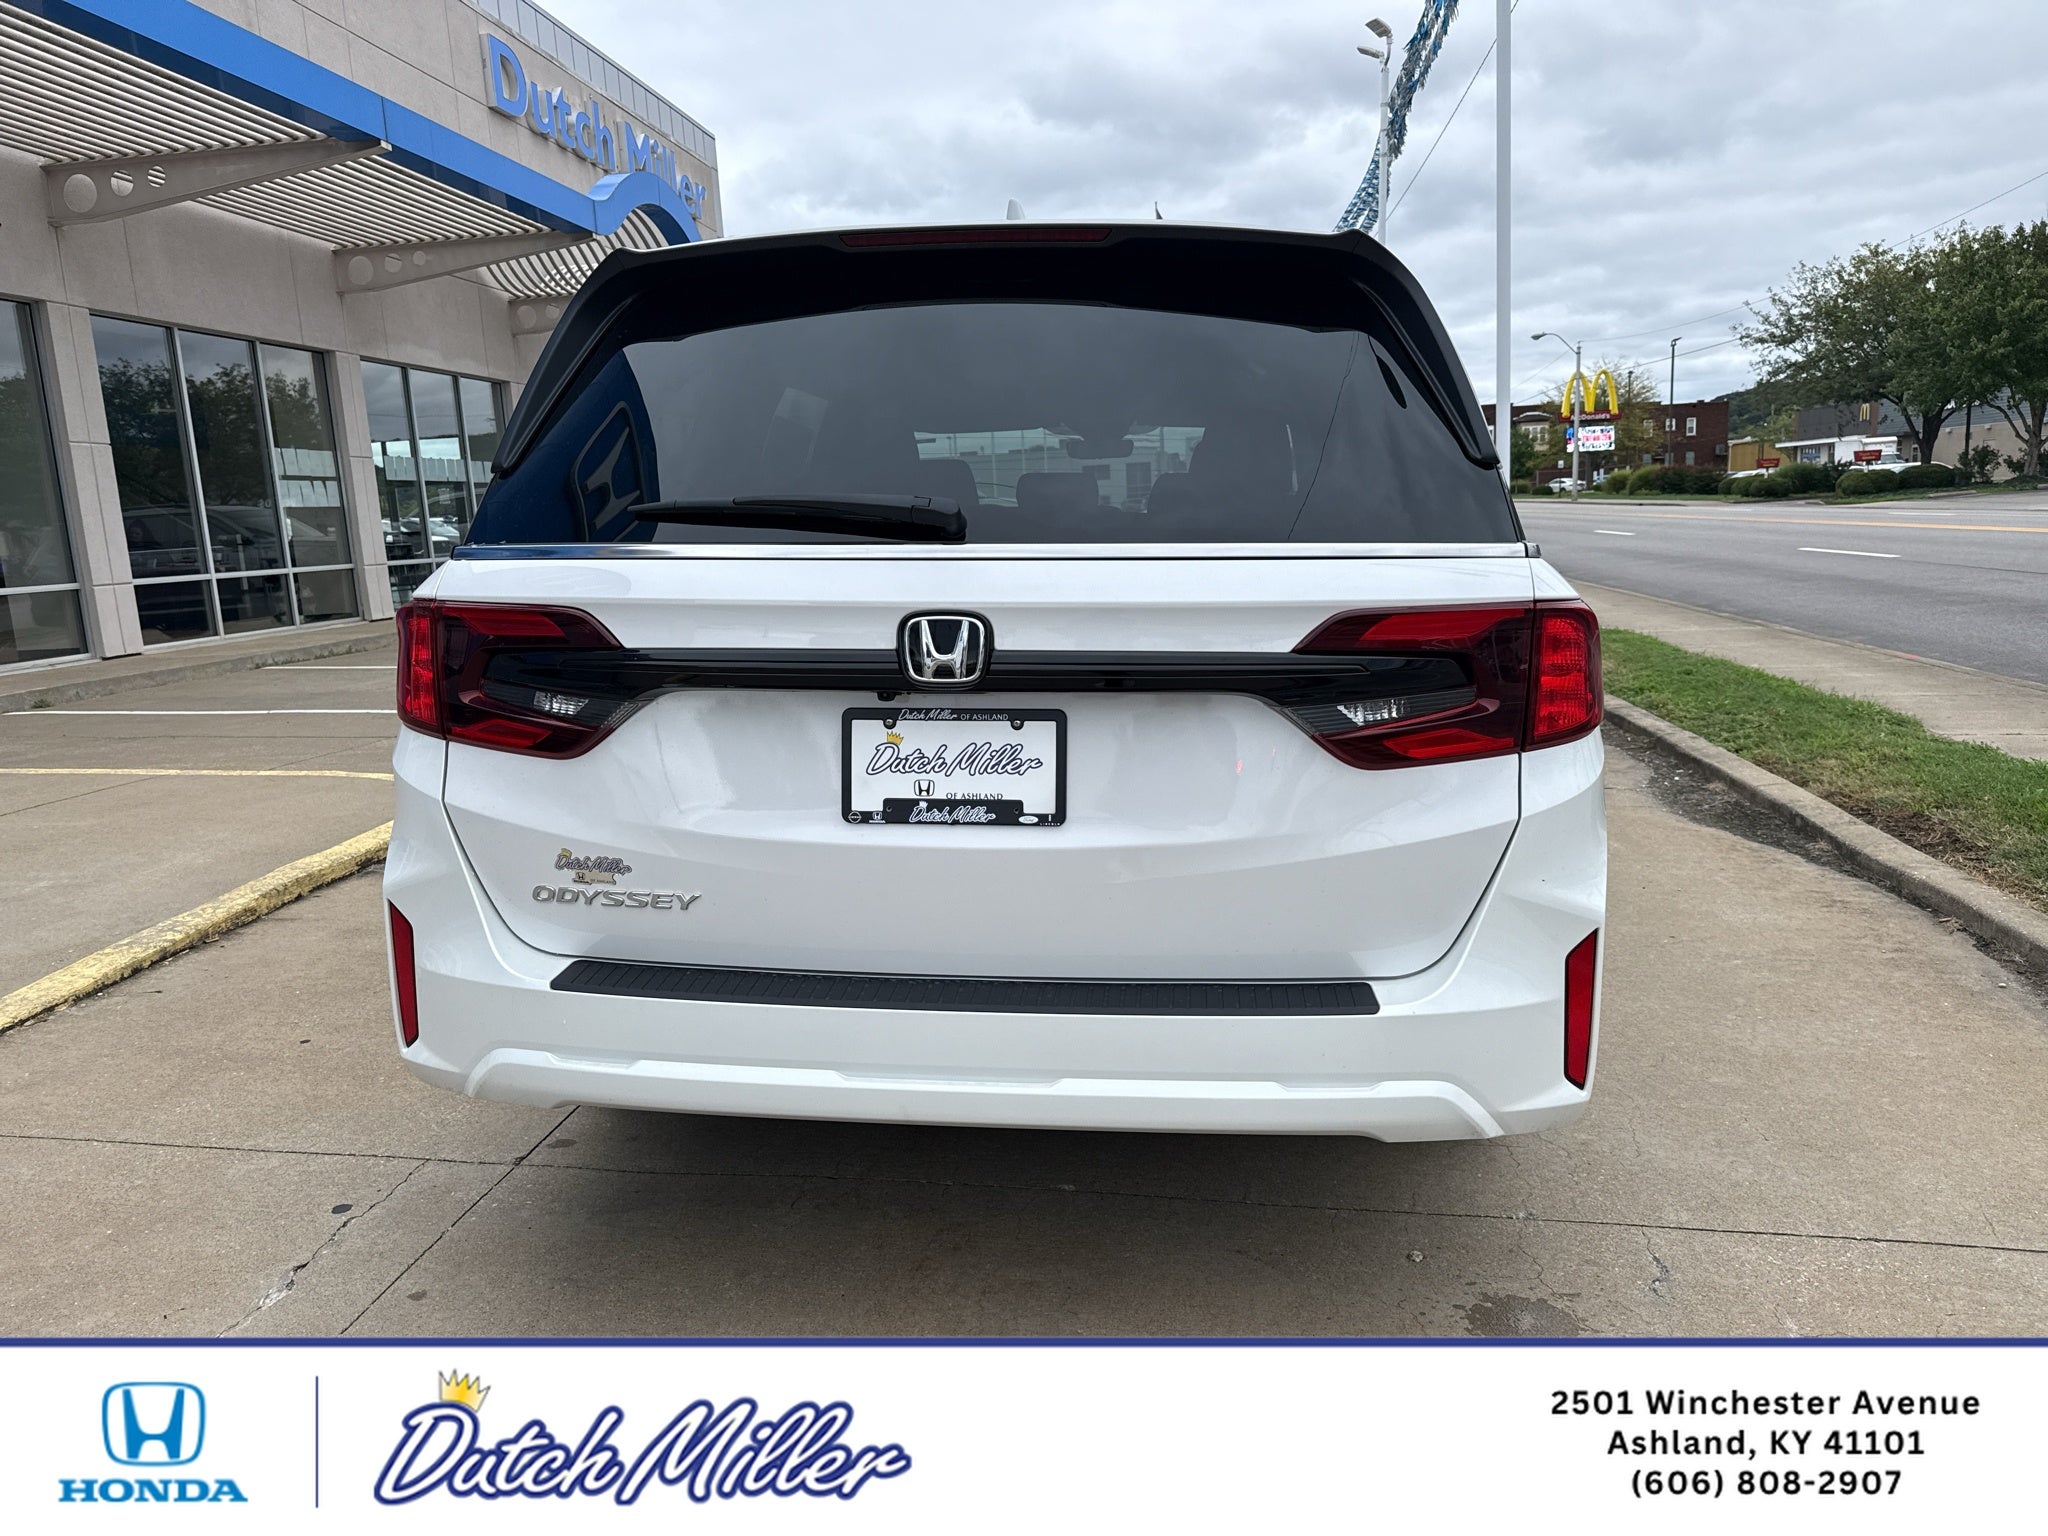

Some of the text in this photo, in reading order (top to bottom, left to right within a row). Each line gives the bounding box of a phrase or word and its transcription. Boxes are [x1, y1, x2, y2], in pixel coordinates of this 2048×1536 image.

[483, 32, 707, 220] Dutch Miller
[898, 709, 1009, 721] Dutch Miller OF ASHLAND
[866, 741, 1044, 777] Dutch Miller
[946, 792, 1004, 800] OF ASHLAND
[909, 804, 997, 824] Dutch Miller
[555, 853, 633, 876] Dutch Miller
[532, 885, 702, 911] ODYSSEY
